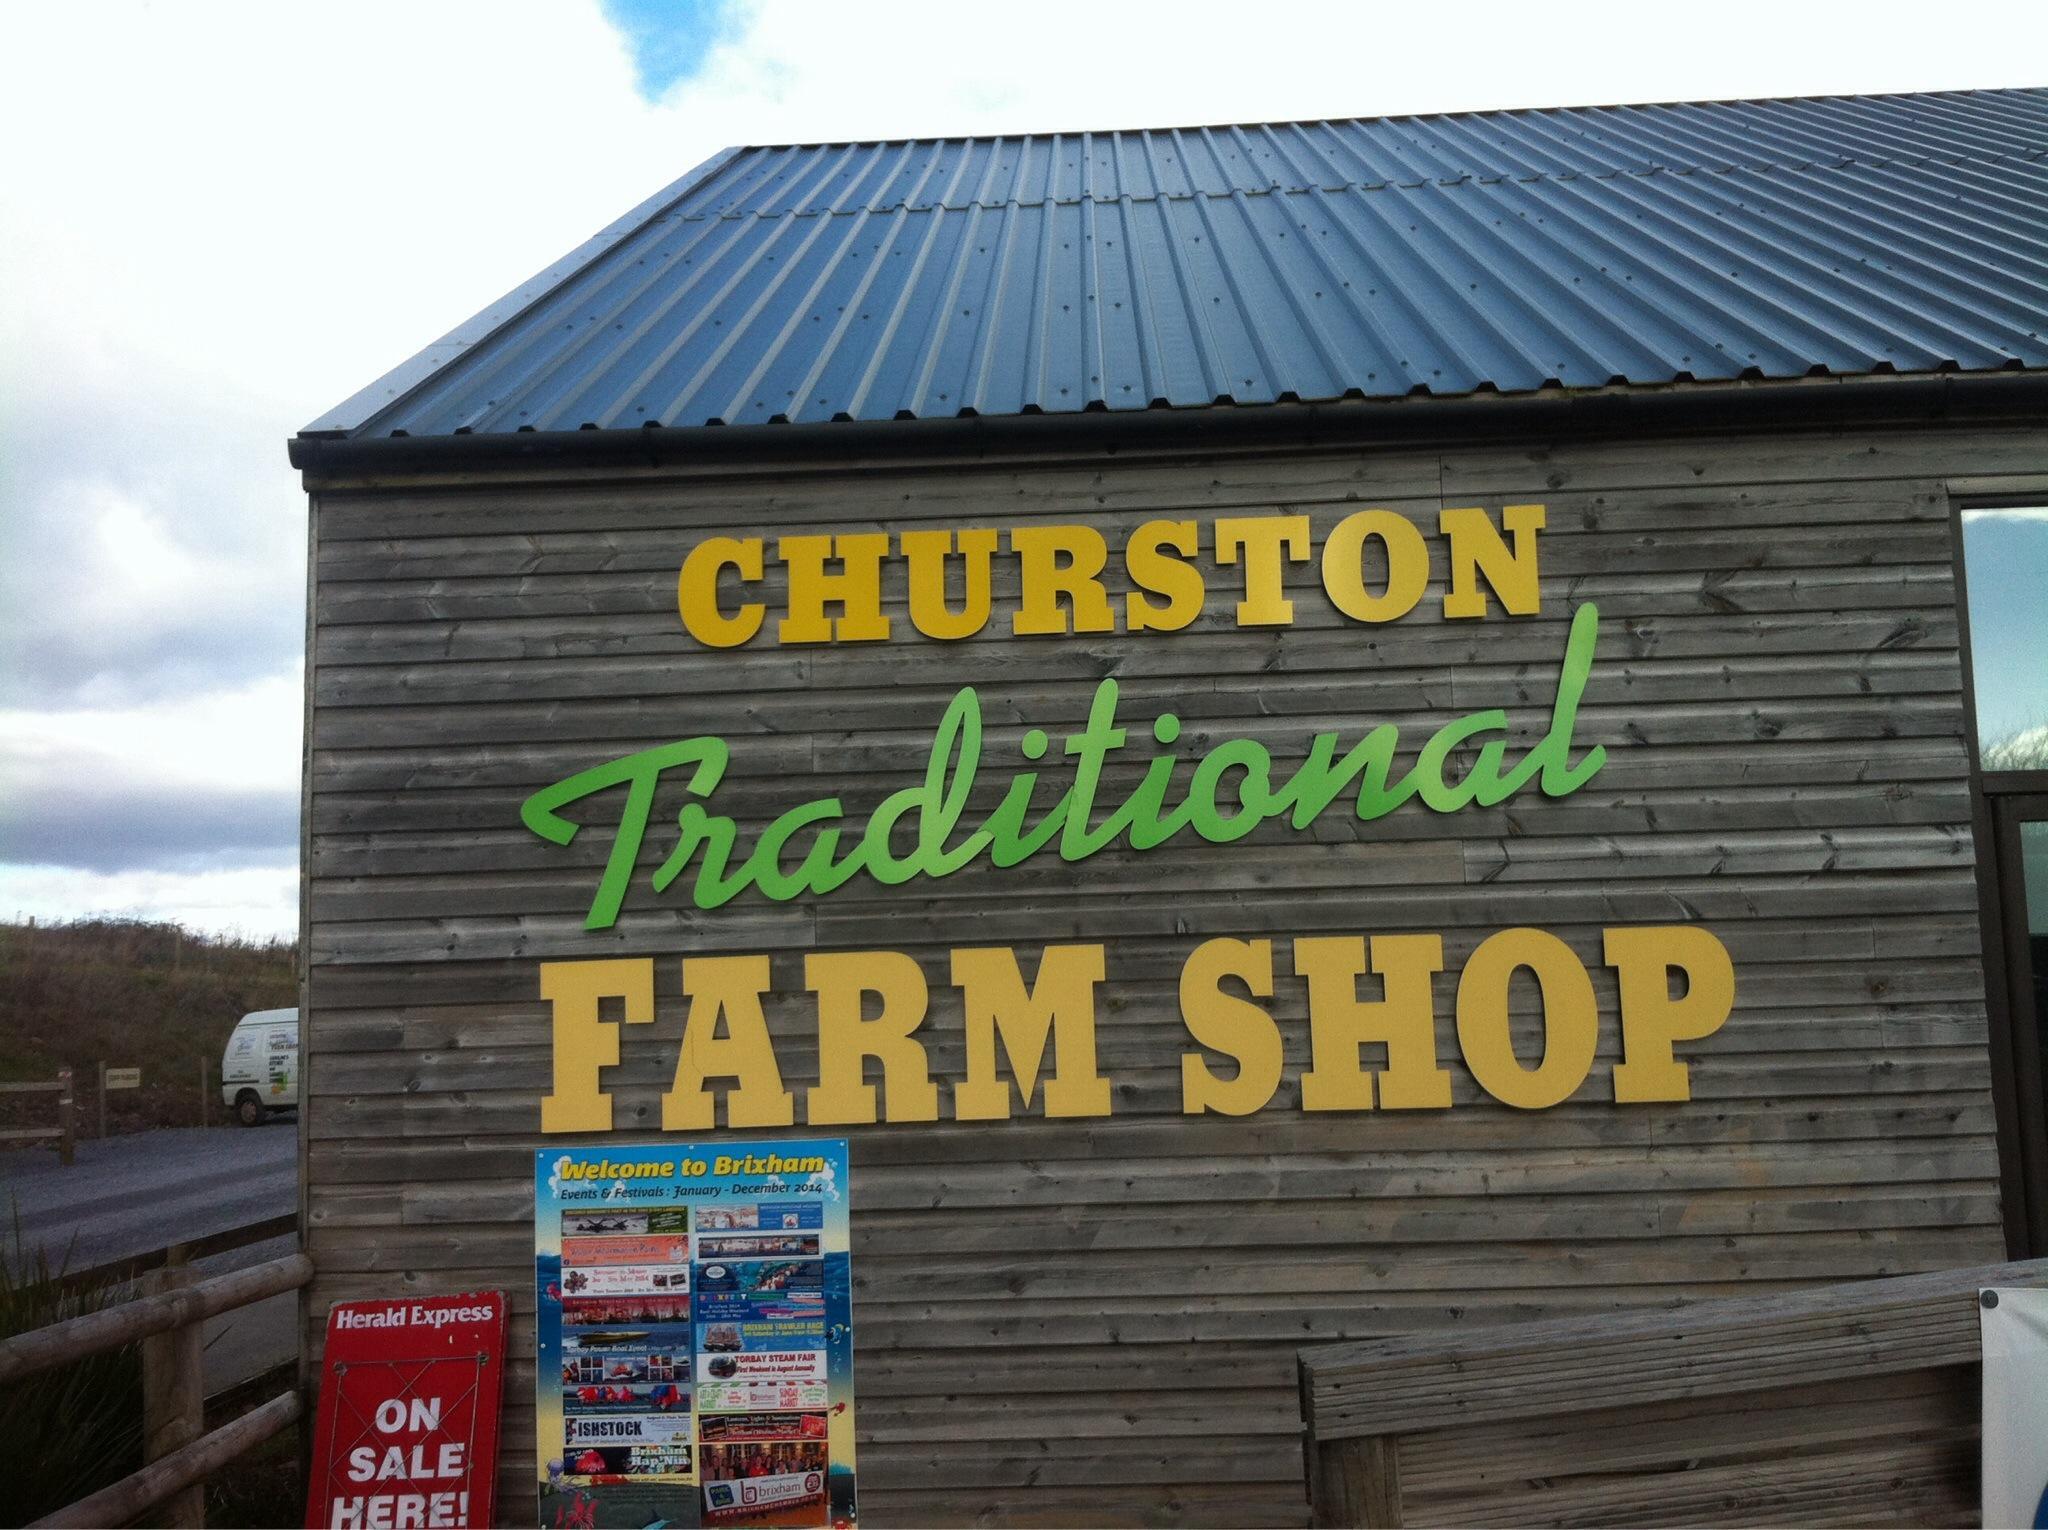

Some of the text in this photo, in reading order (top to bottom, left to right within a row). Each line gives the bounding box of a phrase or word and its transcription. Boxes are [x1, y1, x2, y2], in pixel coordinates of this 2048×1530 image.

[678, 504, 1546, 646] CHURSTON
[520, 602, 1607, 930] Traditional
[540, 926, 1735, 1132] FARM SHOP
[561, 1153, 825, 1181] Welcome to Brixham
[560, 1188, 598, 1200] Events
[601, 1187, 611, 1199] &
[614, 1185, 664, 1198] Festivals
[672, 1184, 722, 1200] January
[731, 1182, 791, 1195] December
[794, 1182, 823, 1194] 2014
[336, 1305, 493, 1329] Herald Express
[734, 1352, 817, 1364] TORBAY STEAM FAIR
[375, 1396, 441, 1434] ON
[347, 1442, 465, 1482] SALE
[758, 1482, 801, 1498] brixham
[330, 1490, 469, 1530] HERE!
